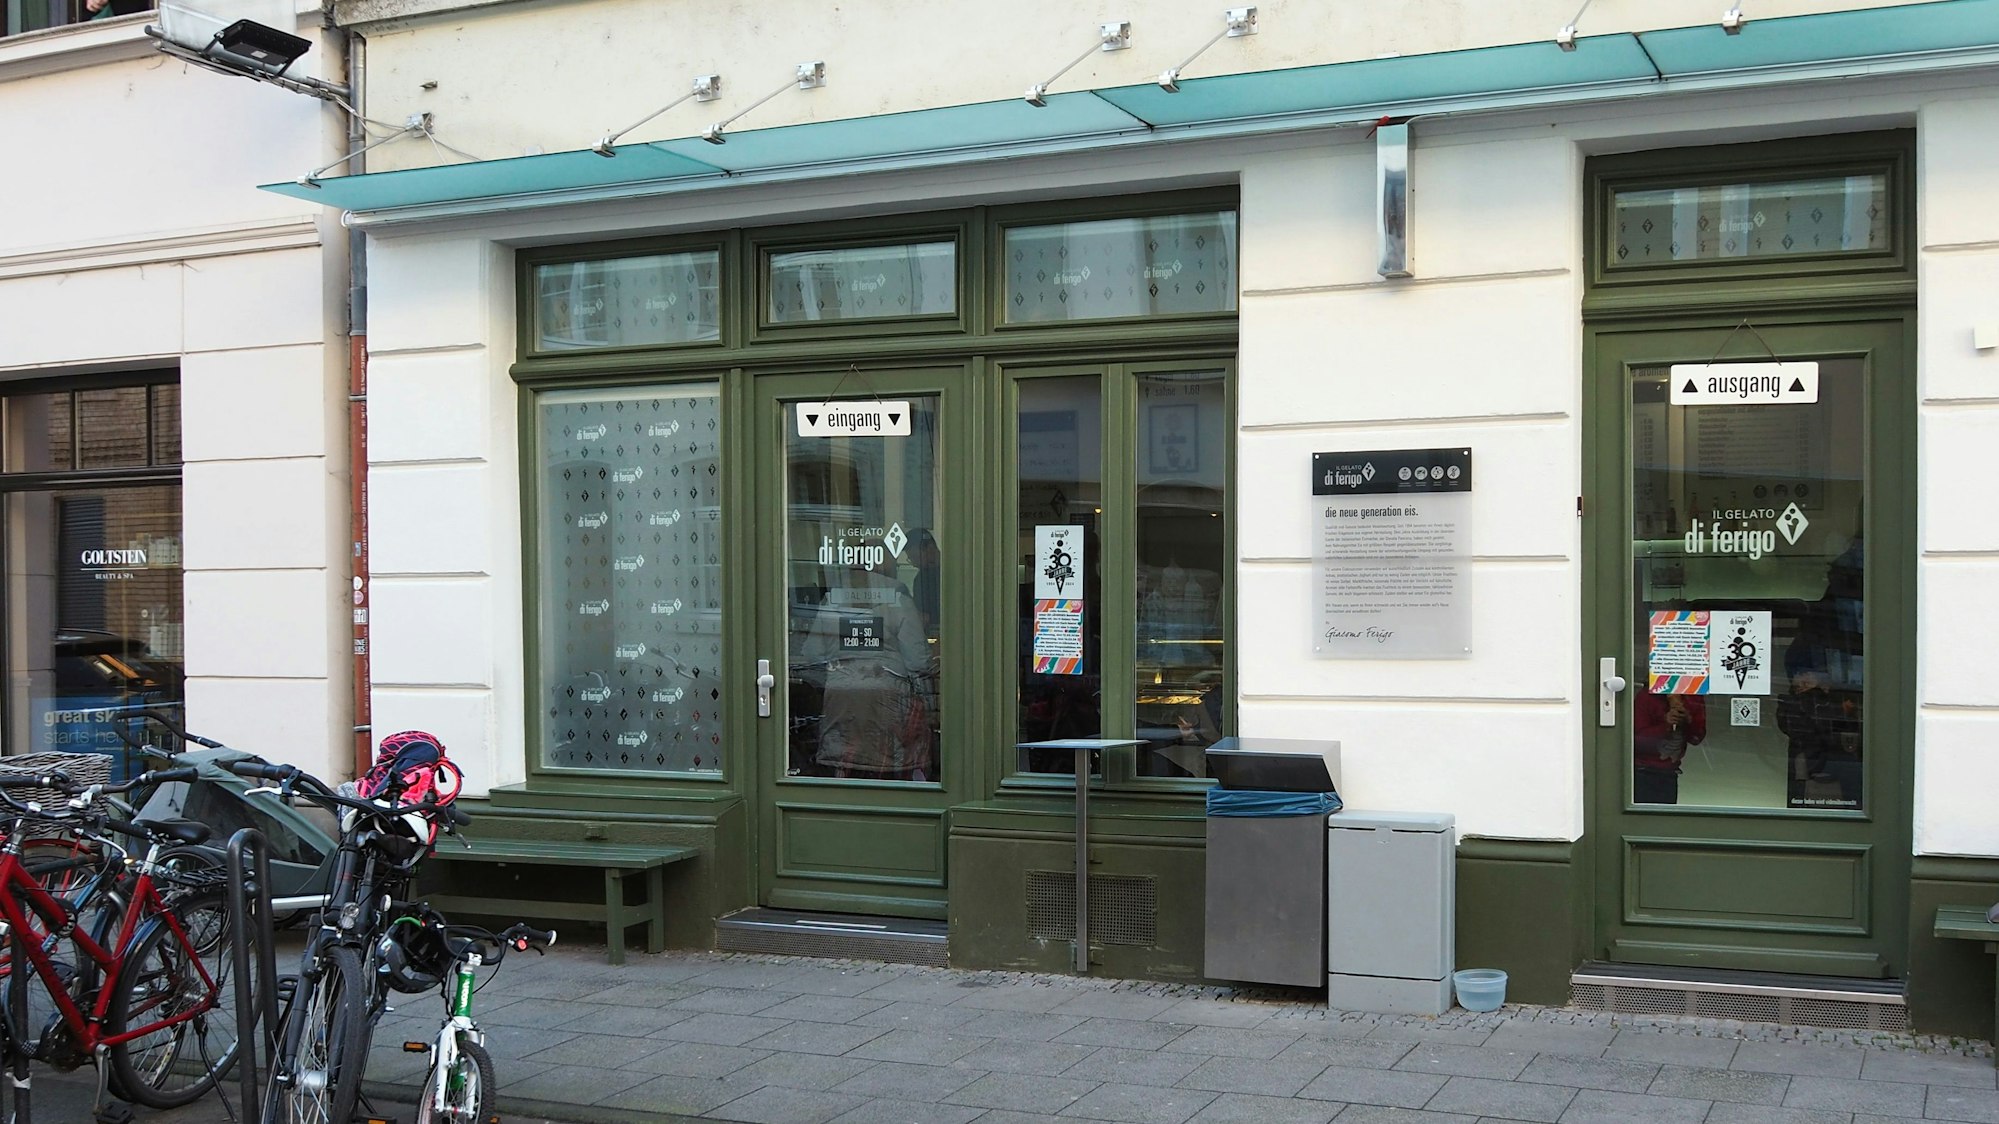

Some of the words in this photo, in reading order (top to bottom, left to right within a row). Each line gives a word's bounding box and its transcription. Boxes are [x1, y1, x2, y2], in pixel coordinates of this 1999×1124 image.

[1708, 376, 1781, 398] ausgang
[828, 407, 881, 431] eingang
[1324, 470, 1333, 486] di
[1335, 470, 1362, 488] ferigo
[1325, 507, 1337, 518] die
[1340, 508, 1358, 518] neue
[1361, 506, 1402, 519] generation
[1404, 505, 1419, 517] eis.
[1713, 510, 1723, 518] IL
[1725, 508, 1775, 519] GELATO
[838, 529, 845, 537] IL
[847, 528, 883, 537] GELATO
[1685, 518, 1703, 553] di
[1711, 521, 1775, 560] ferigo
[81, 549, 147, 565] GOLTSTEIN
[819, 536, 832, 565] di
[838, 536, 883, 571] ferigo
[1049, 552, 1072, 571] 30
[864, 628, 872, 636] SO
[1325, 626, 1362, 643] Giacomo
[1366, 626, 1394, 643] Ferigo
[844, 637, 858, 646] 12:00
[864, 638, 879, 647] 21:00
[1727, 642, 1756, 661] 30
[43, 710, 90, 726] great
[43, 730, 90, 744] starts
